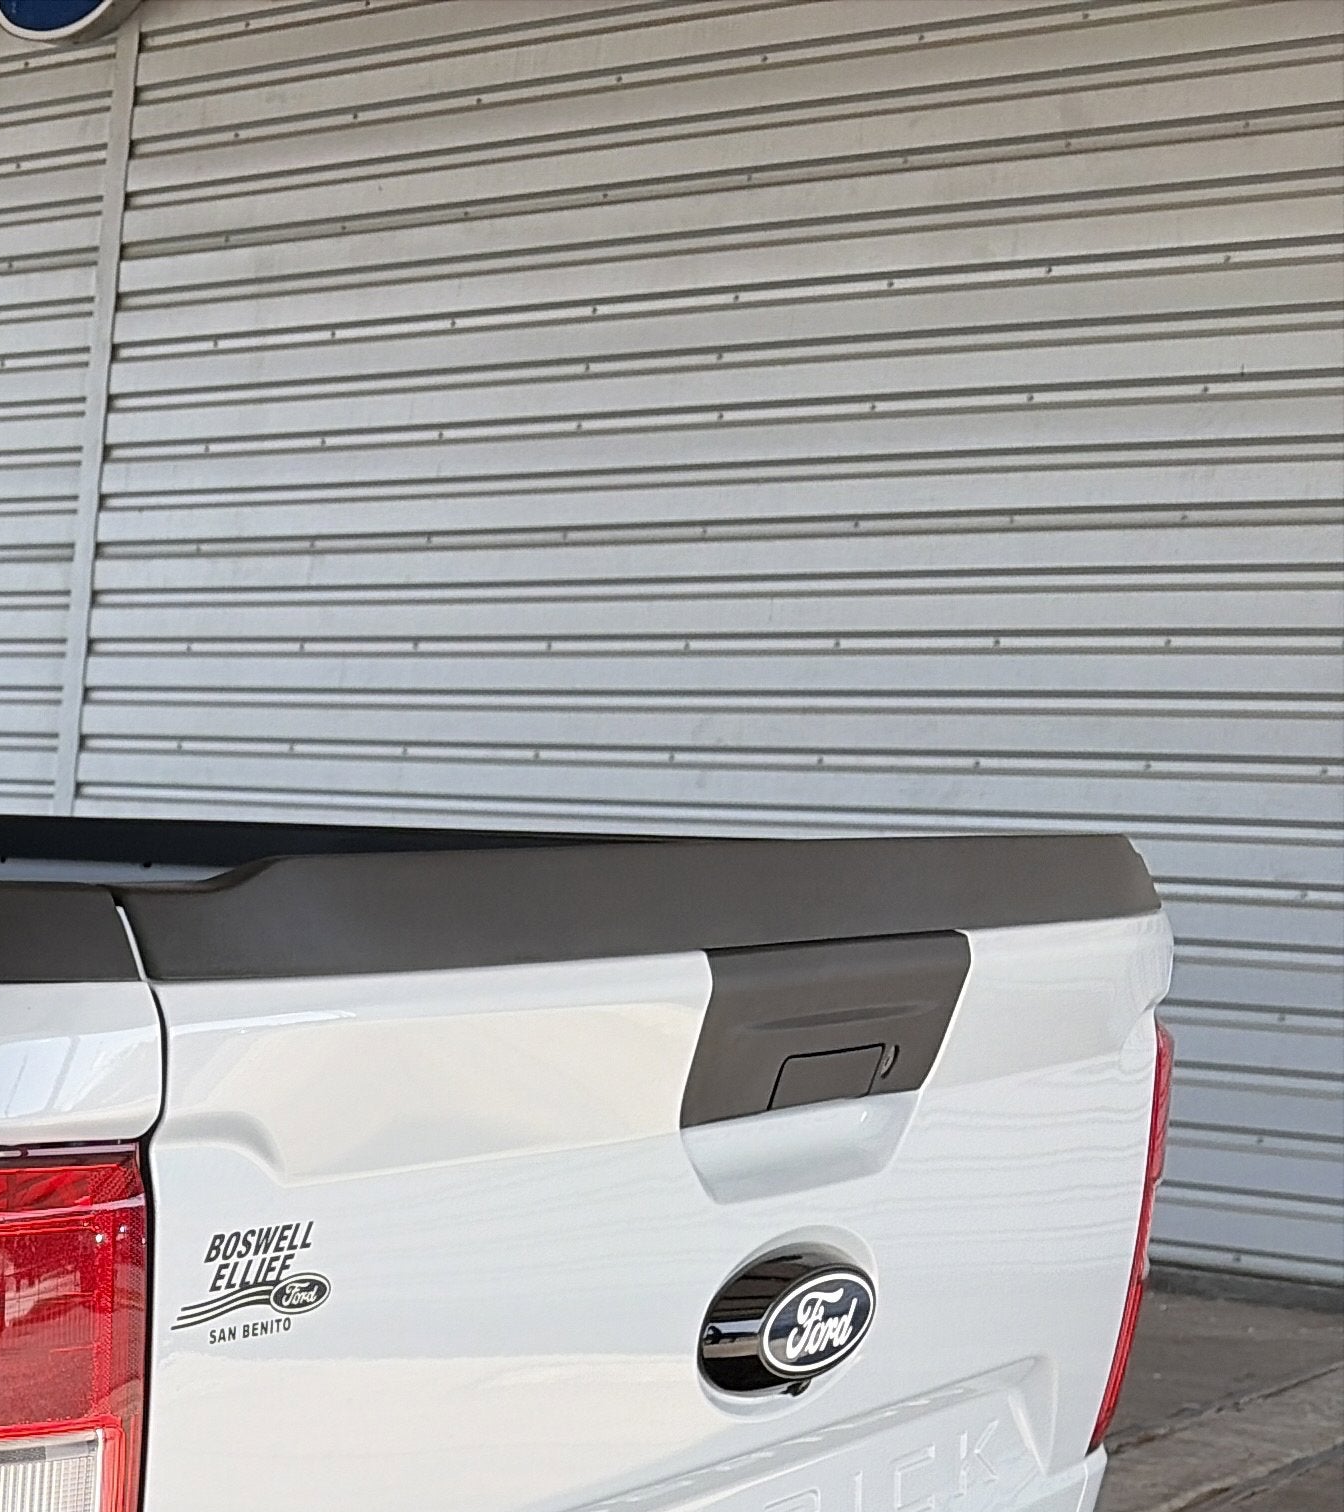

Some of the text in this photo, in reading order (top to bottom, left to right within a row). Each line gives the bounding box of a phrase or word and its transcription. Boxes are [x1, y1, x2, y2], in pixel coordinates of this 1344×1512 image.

[204, 1221, 314, 1263] BOSWELL
[282, 1282, 319, 1306] Ford
[209, 1317, 291, 1344] SAN BENITO
[786, 1288, 858, 1360] Ford
